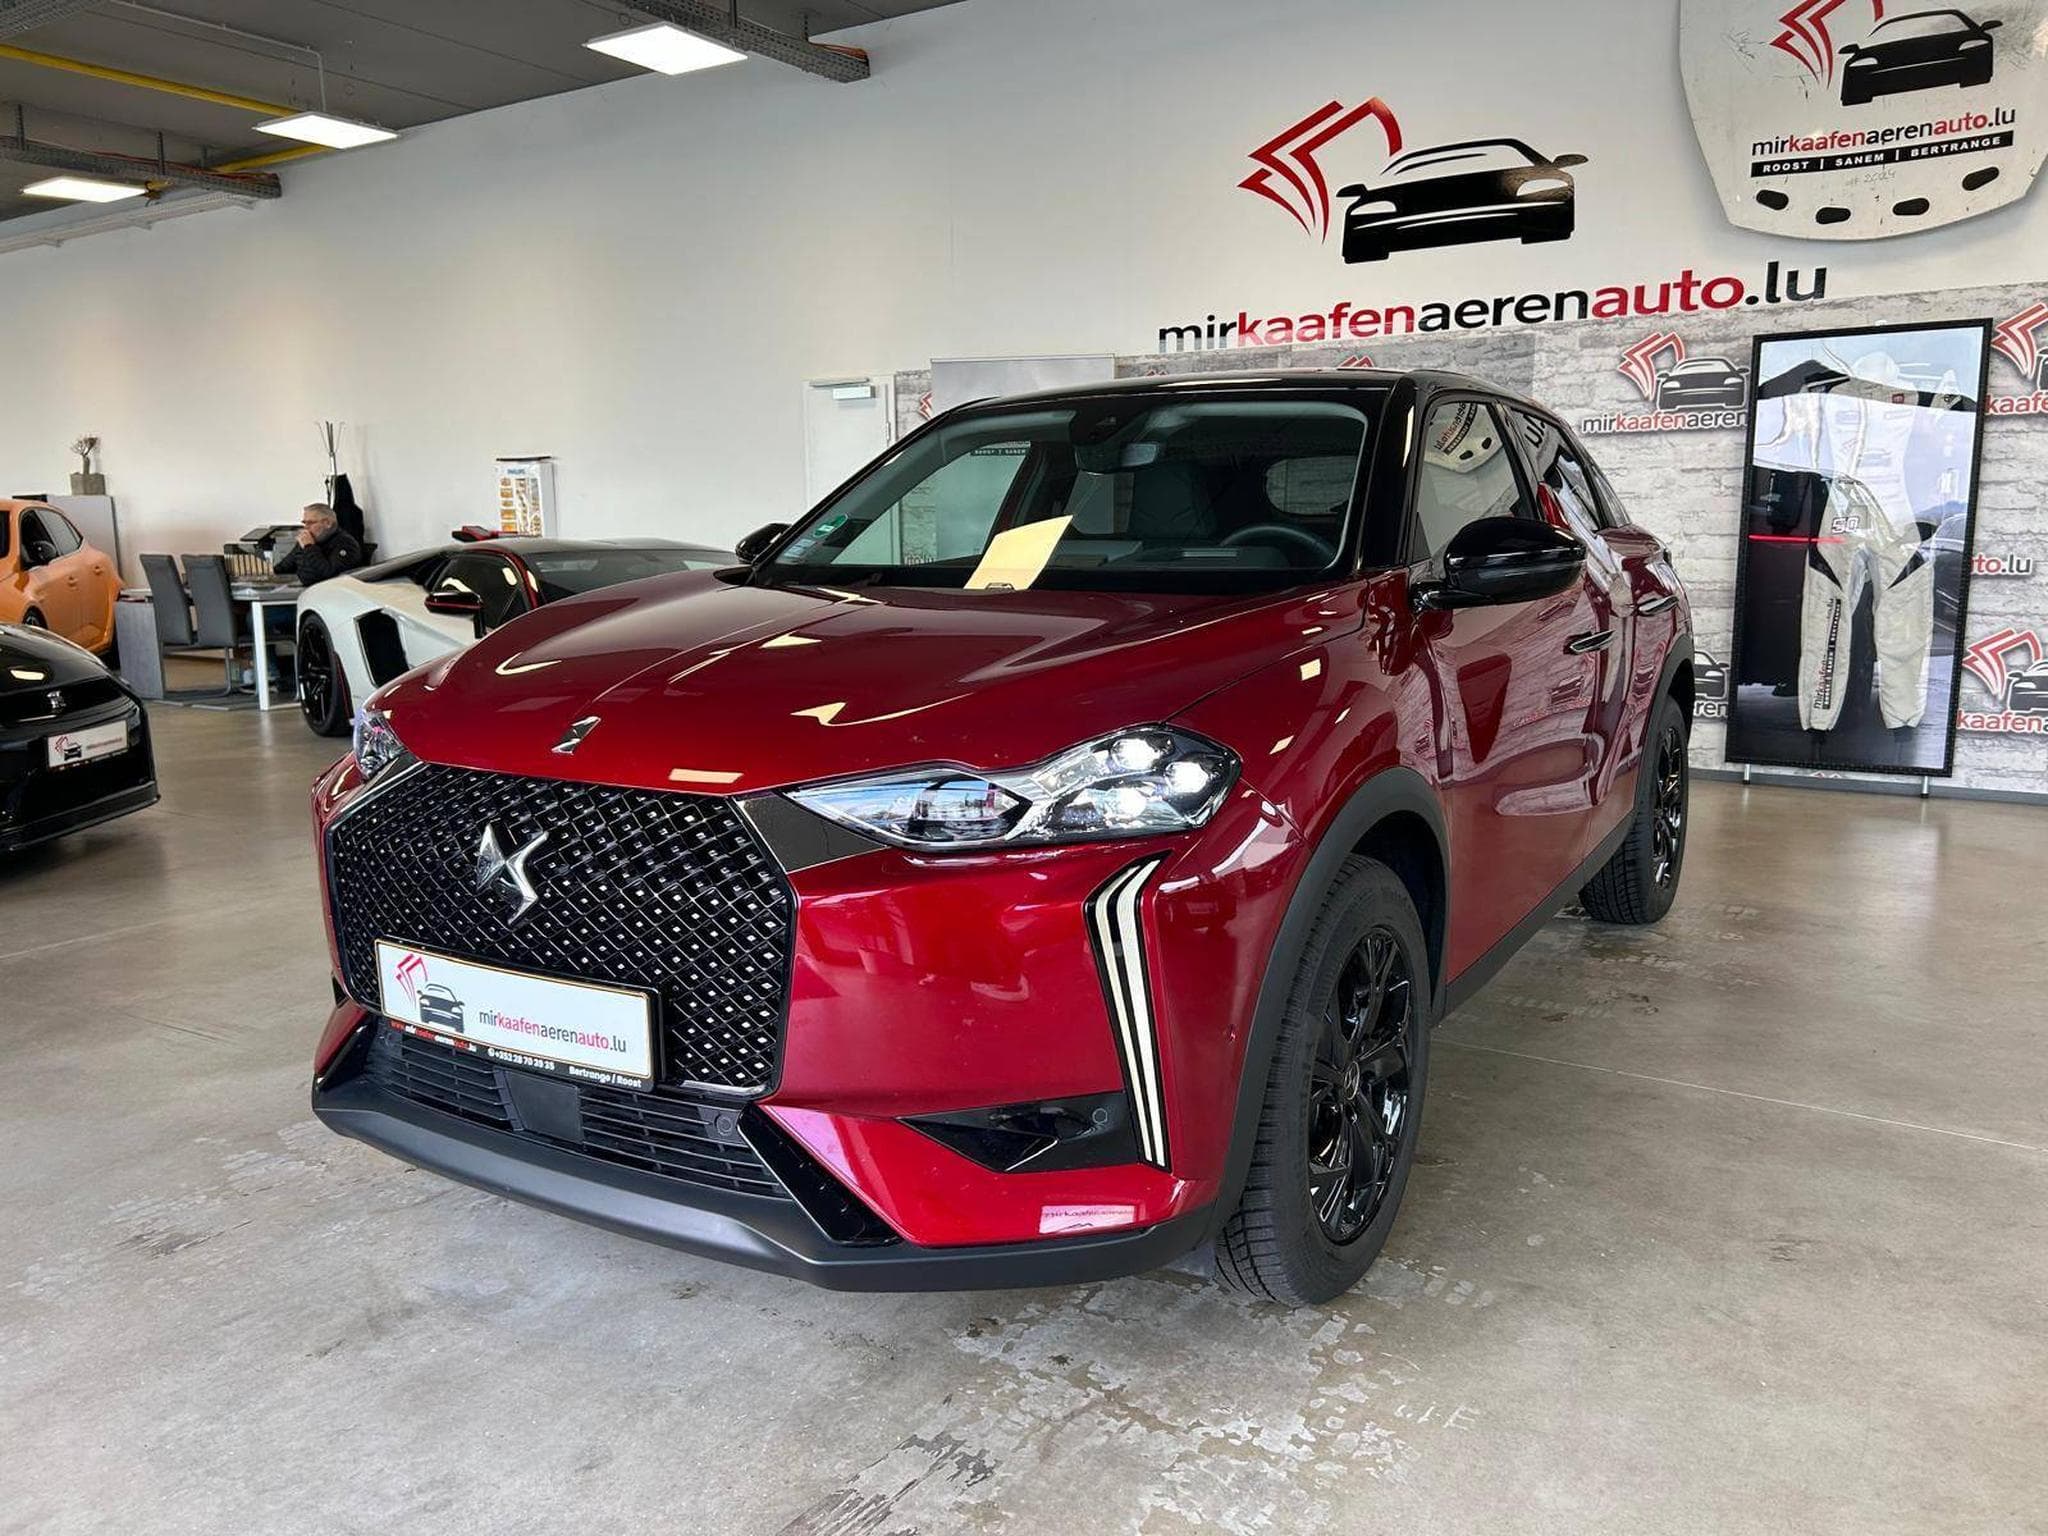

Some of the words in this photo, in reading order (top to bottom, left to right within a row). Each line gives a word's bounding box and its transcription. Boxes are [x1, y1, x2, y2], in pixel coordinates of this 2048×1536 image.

[1752, 107, 2016, 157] mirkaafenaerenauto.lu
[1762, 160, 1810, 174] ROOST
[1835, 152, 1885, 167] SANEM
[1910, 136, 2002, 158] BERTRANGE
[1158, 261, 1828, 355] mirkaafenaerenauto.lu
[479, 1008, 627, 1053] mirkaafenaerenauto.lu
